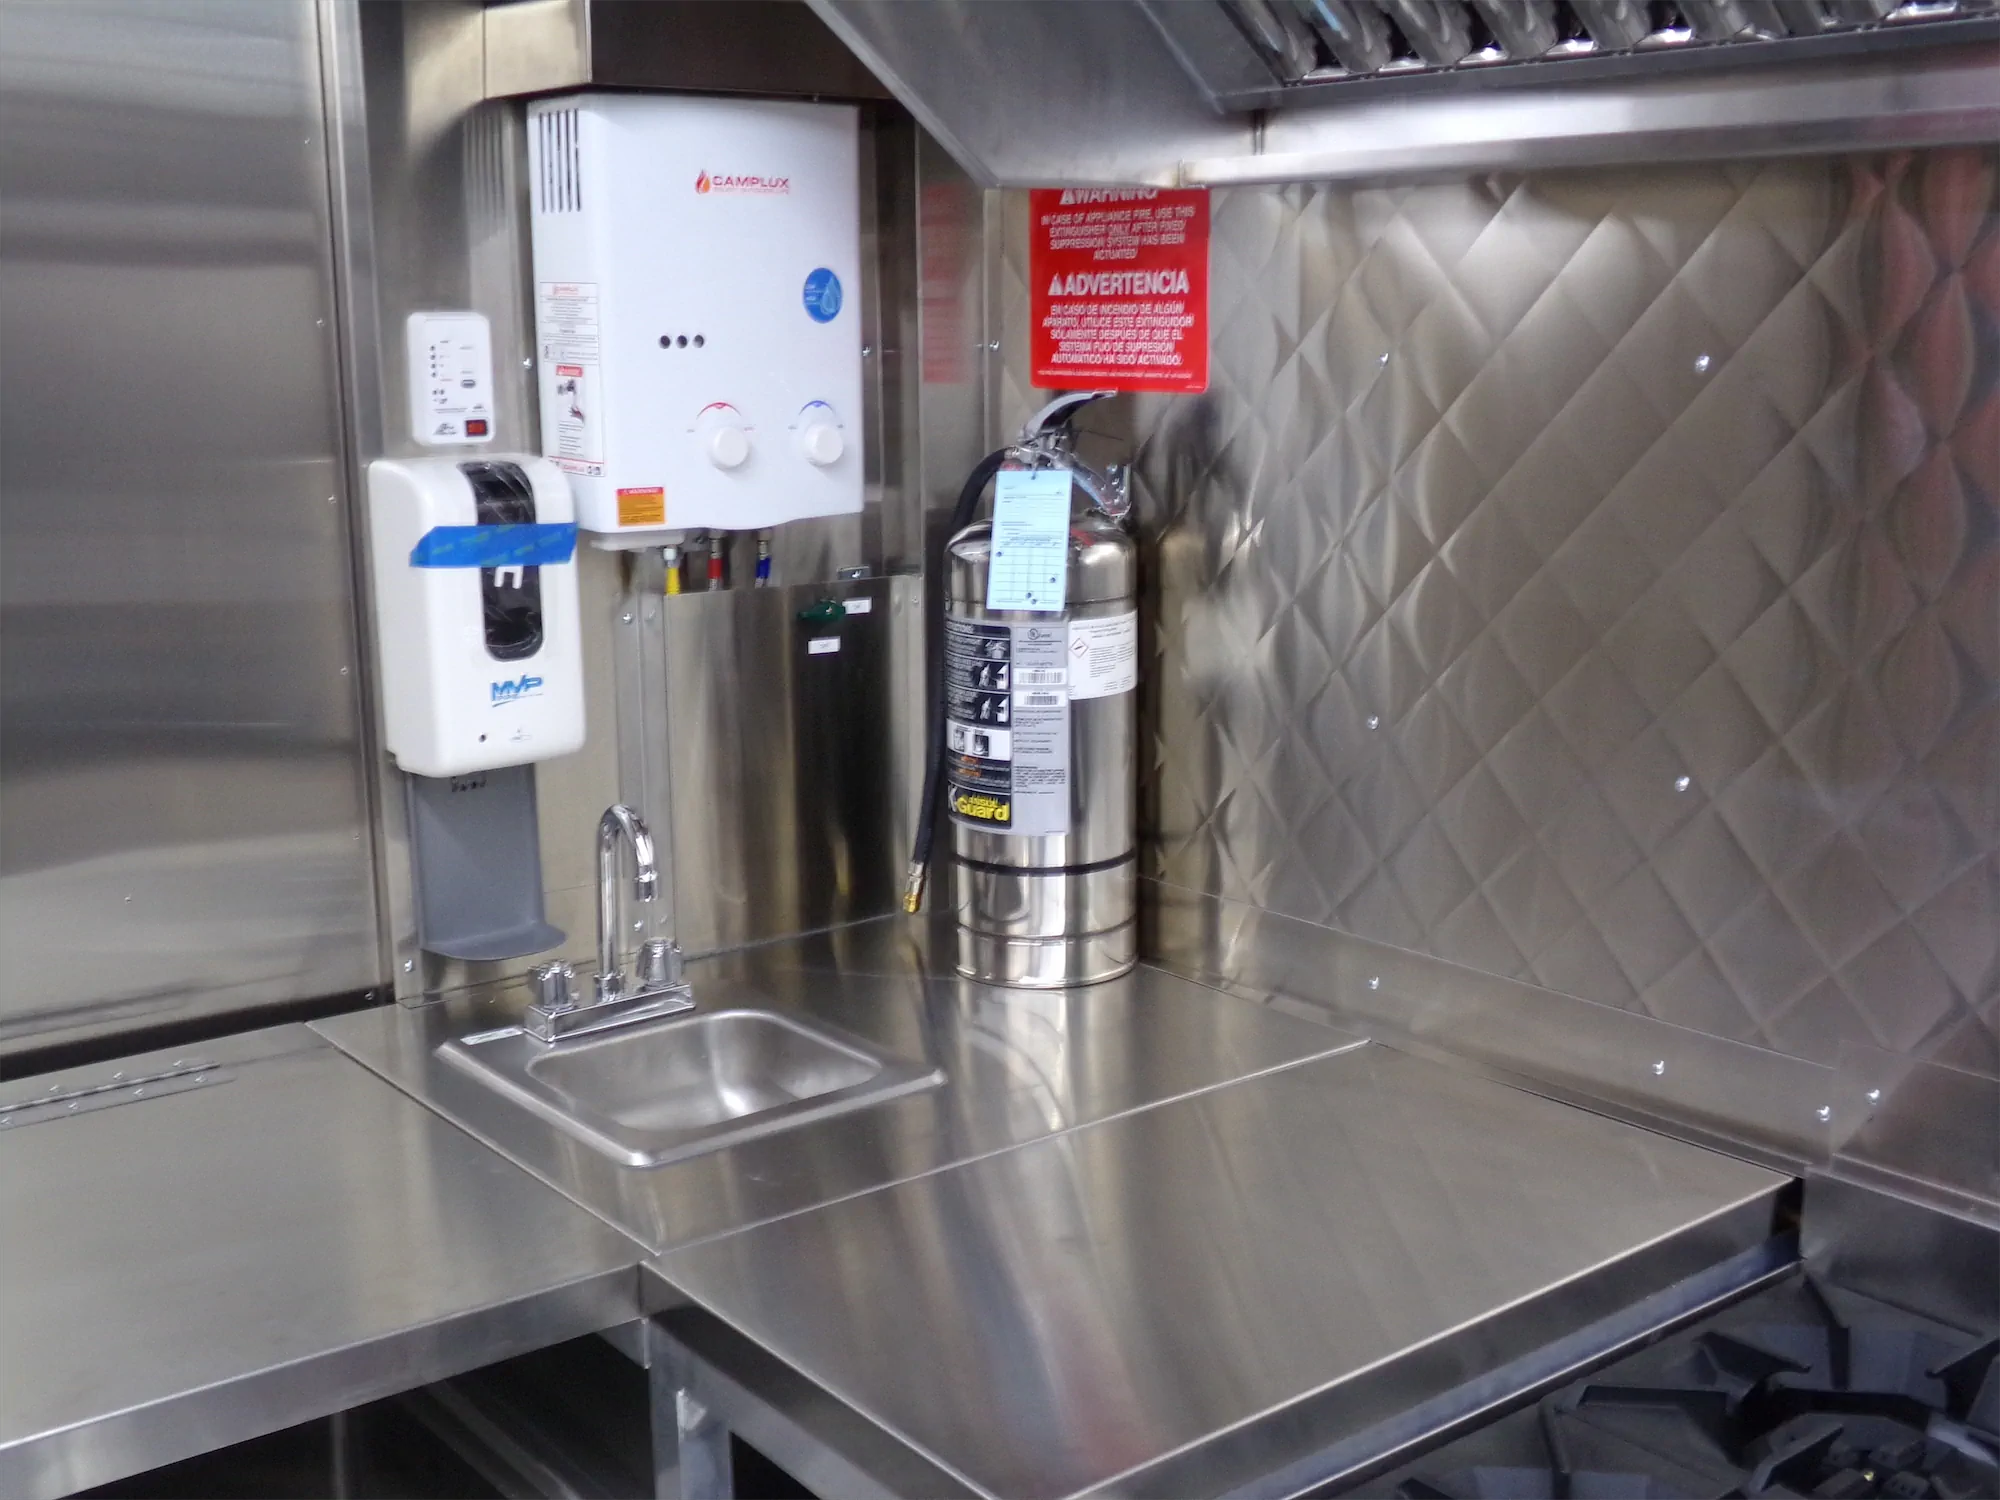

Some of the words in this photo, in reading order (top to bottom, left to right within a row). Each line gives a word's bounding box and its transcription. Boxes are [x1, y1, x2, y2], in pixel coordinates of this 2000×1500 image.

[712, 176, 789, 188] CAMPLUX
[1050, 214, 1072, 225] CASE
[1073, 212, 1085, 223] OF
[1086, 210, 1131, 222] APPLIANCE
[1155, 207, 1173, 218] USE
[1175, 205, 1195, 217] THIS
[1050, 225, 1105, 237] EXTINGUISHER
[1108, 223, 1131, 235] ONLY
[1132, 221, 1157, 233] AFTER
[1160, 220, 1185, 232] FIXED
[1050, 237, 1104, 249] SUPPRESSION
[1106, 236, 1140, 247] SYSTEM
[1141, 234, 1158, 245] HAS
[1160, 233, 1185, 244] BEEN
[1093, 249, 1138, 260] ACTUATED
[1064, 270, 1190, 296] ADVERTENCIA
[1051, 304, 1061, 315] EN
[1063, 304, 1085, 315] CASO
[1086, 304, 1098, 315] DE
[1100, 303, 1139, 315] INCENDIO
[1140, 303, 1151, 314] DE
[1081, 316, 1112, 327] UTILICE
[1113, 316, 1134, 327] ESTE
[1136, 315, 1193, 327] EXTINGUIDOR
[1050, 329, 1097, 340] SOLAMENTE
[1139, 329, 1150, 340] DE
[1152, 329, 1170, 340] QUE
[1059, 341, 1091, 353] SISTEMA
[1093, 341, 1112, 353] FIJO
[1113, 341, 1124, 353] DE
[1103, 353, 1116, 365] HA
[1116, 353, 1136, 365] SIDO
[491, 674, 543, 701] MVP
